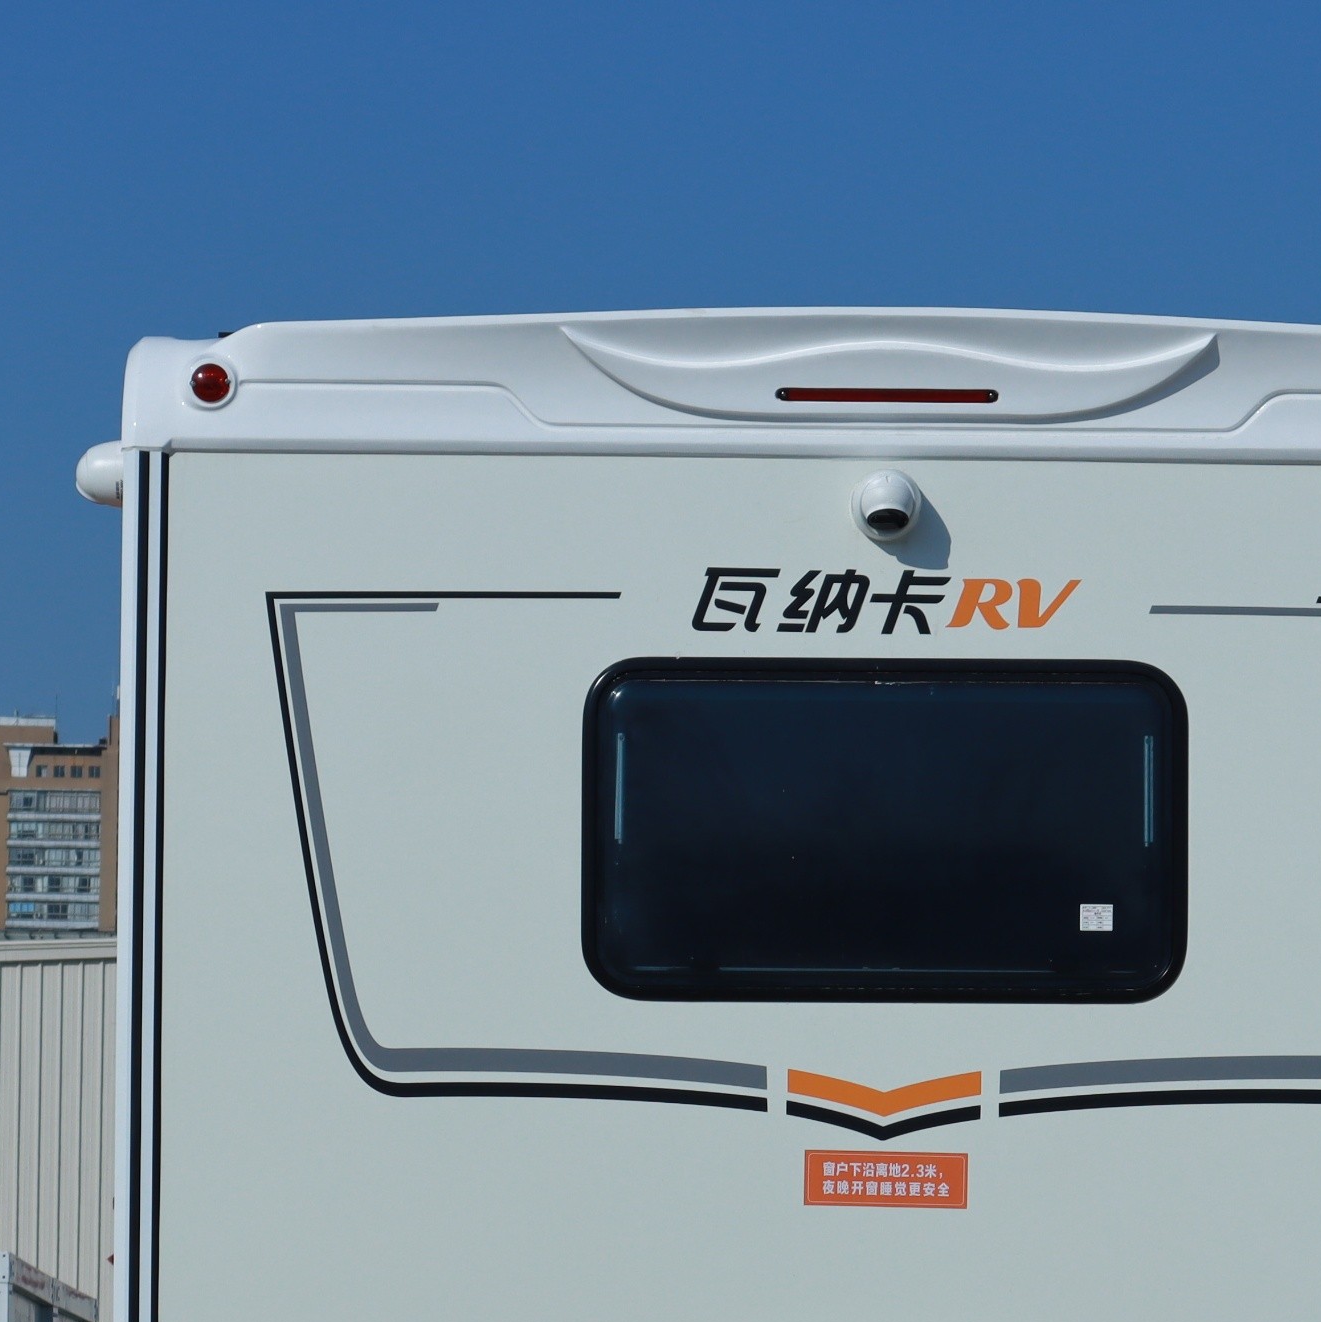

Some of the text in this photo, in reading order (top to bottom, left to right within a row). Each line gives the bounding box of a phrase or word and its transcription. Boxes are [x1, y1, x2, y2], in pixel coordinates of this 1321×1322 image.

[822, 1180, 950, 1197] 夜晚开窗睡觉更安全
